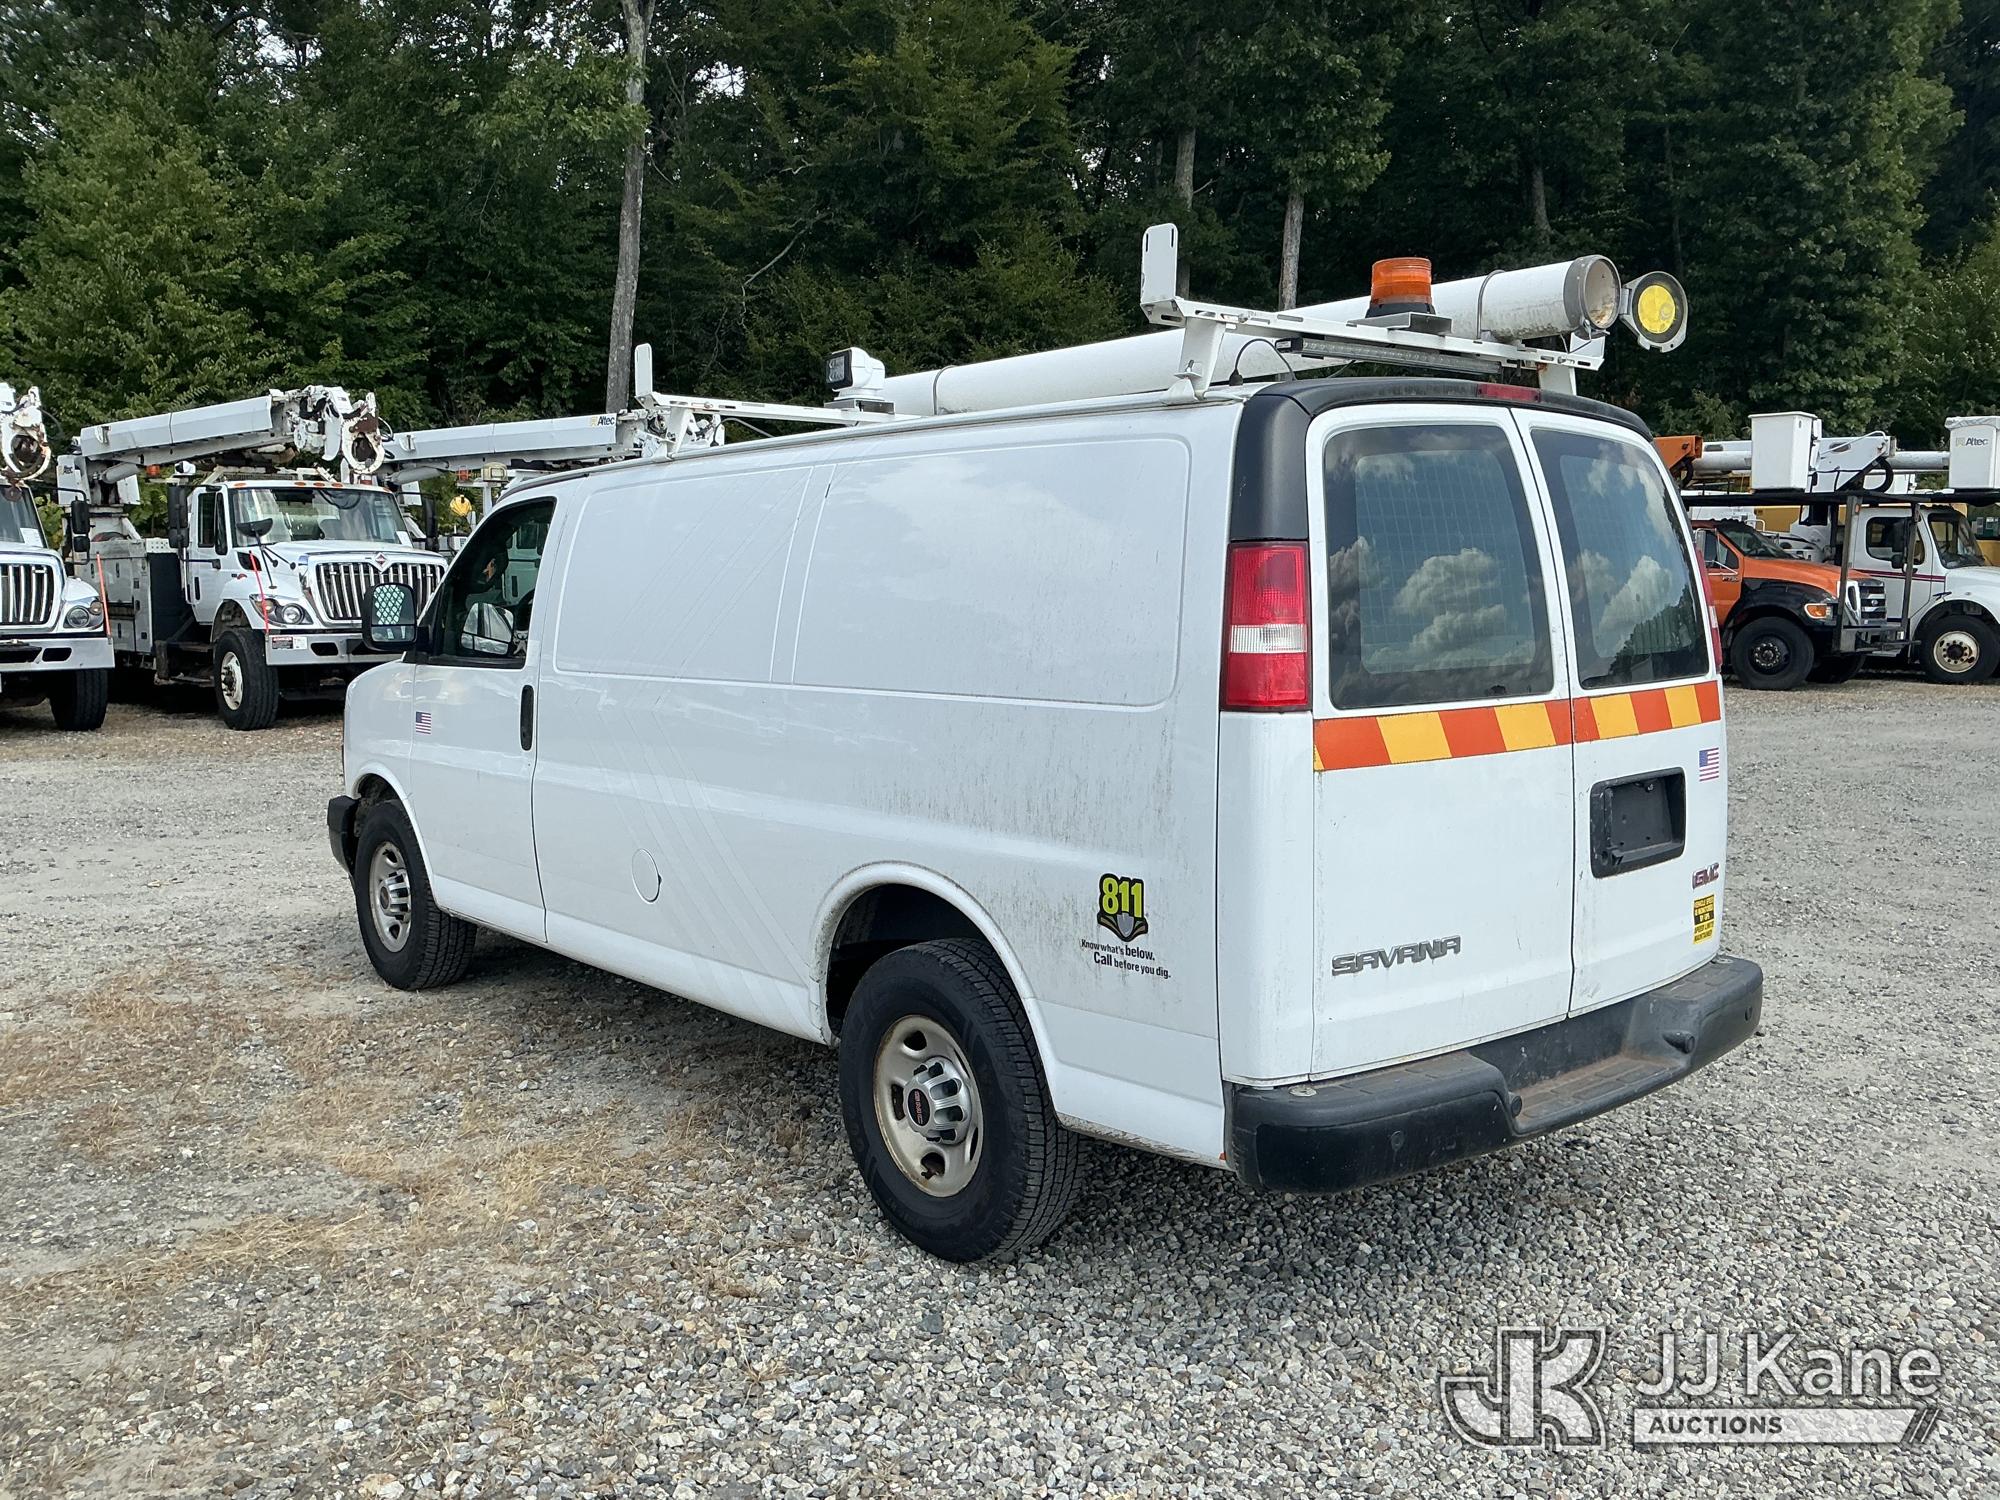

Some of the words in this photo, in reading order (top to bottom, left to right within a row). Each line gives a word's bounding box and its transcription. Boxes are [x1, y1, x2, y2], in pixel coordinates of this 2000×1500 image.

[597, 416, 615, 426] Altec
[1966, 437, 1989, 446] Altec
[1100, 875, 1144, 919] 811
[1081, 939, 1099, 951] Know
[1100, 944, 1124, 955] what's
[1125, 945, 1155, 960] below.
[1332, 935, 1461, 976] SAVANA
[1094, 951, 1112, 967] Call
[1114, 958, 1140, 971] before
[1140, 964, 1155, 976] you
[1156, 967, 1171, 979] dig.
